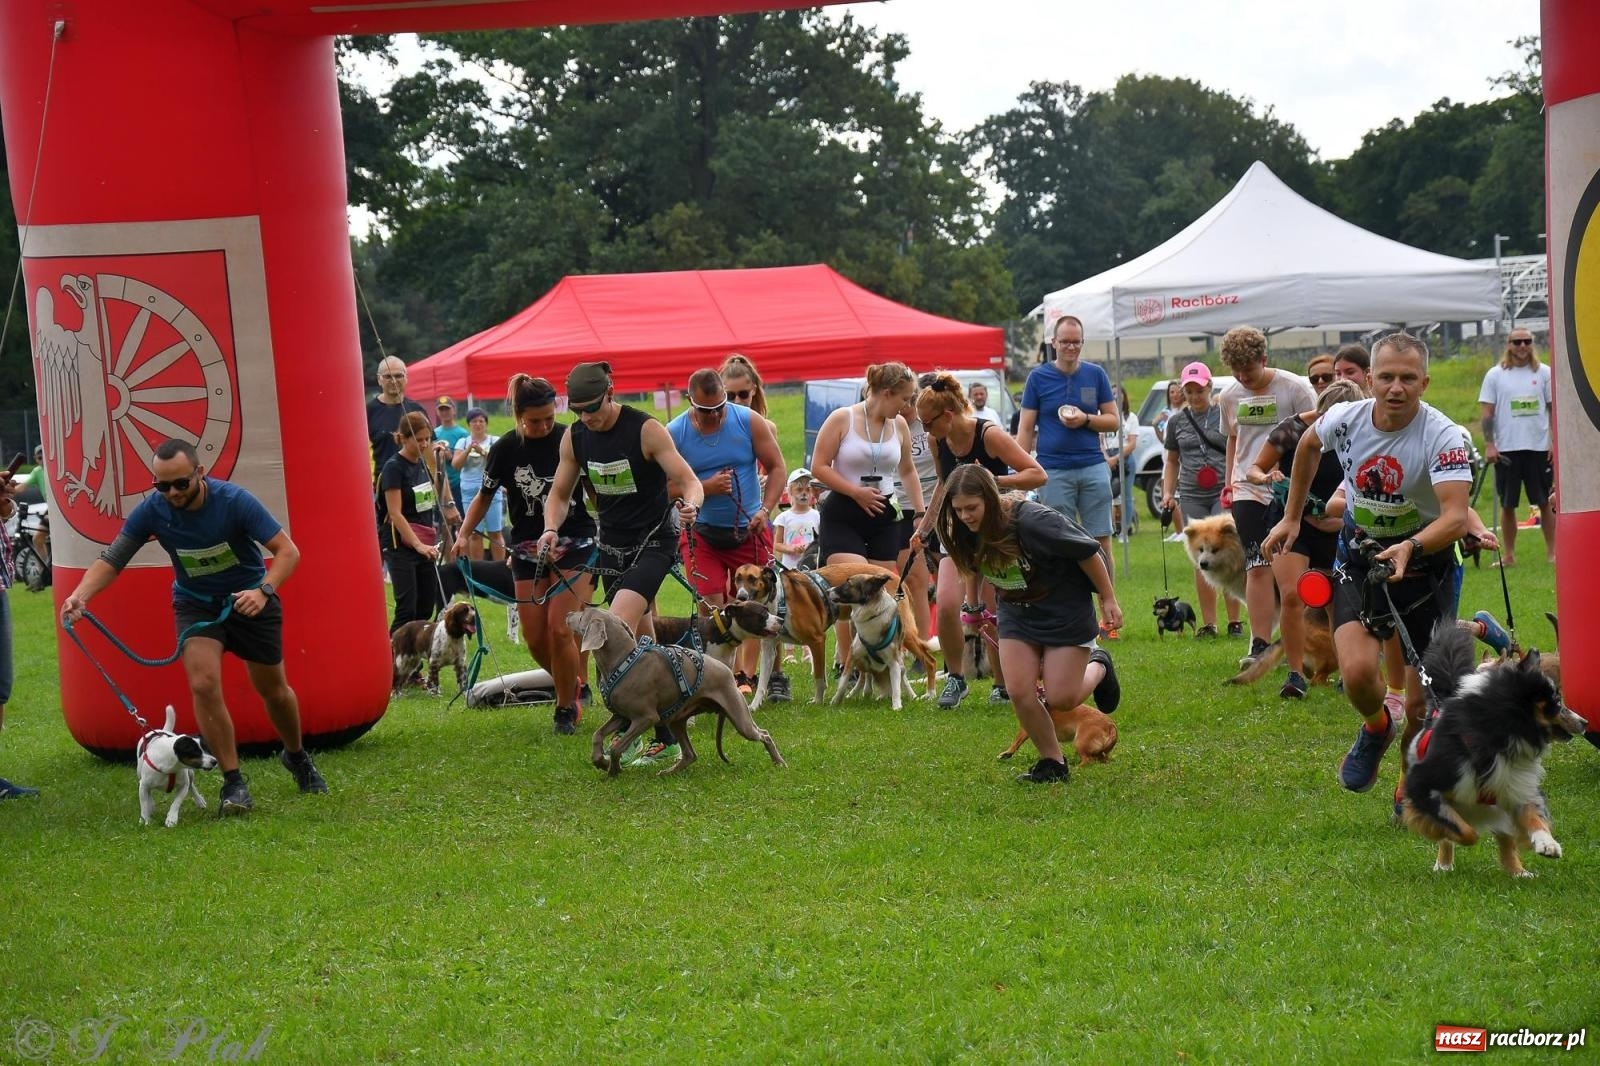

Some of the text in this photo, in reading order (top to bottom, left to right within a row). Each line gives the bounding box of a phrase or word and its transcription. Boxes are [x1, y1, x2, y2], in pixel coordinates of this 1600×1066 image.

[1171, 294, 1239, 309] Racibórz
[1248, 405, 1264, 416] 29
[600, 474, 616, 485] 77
[1374, 515, 1397, 527] 47
